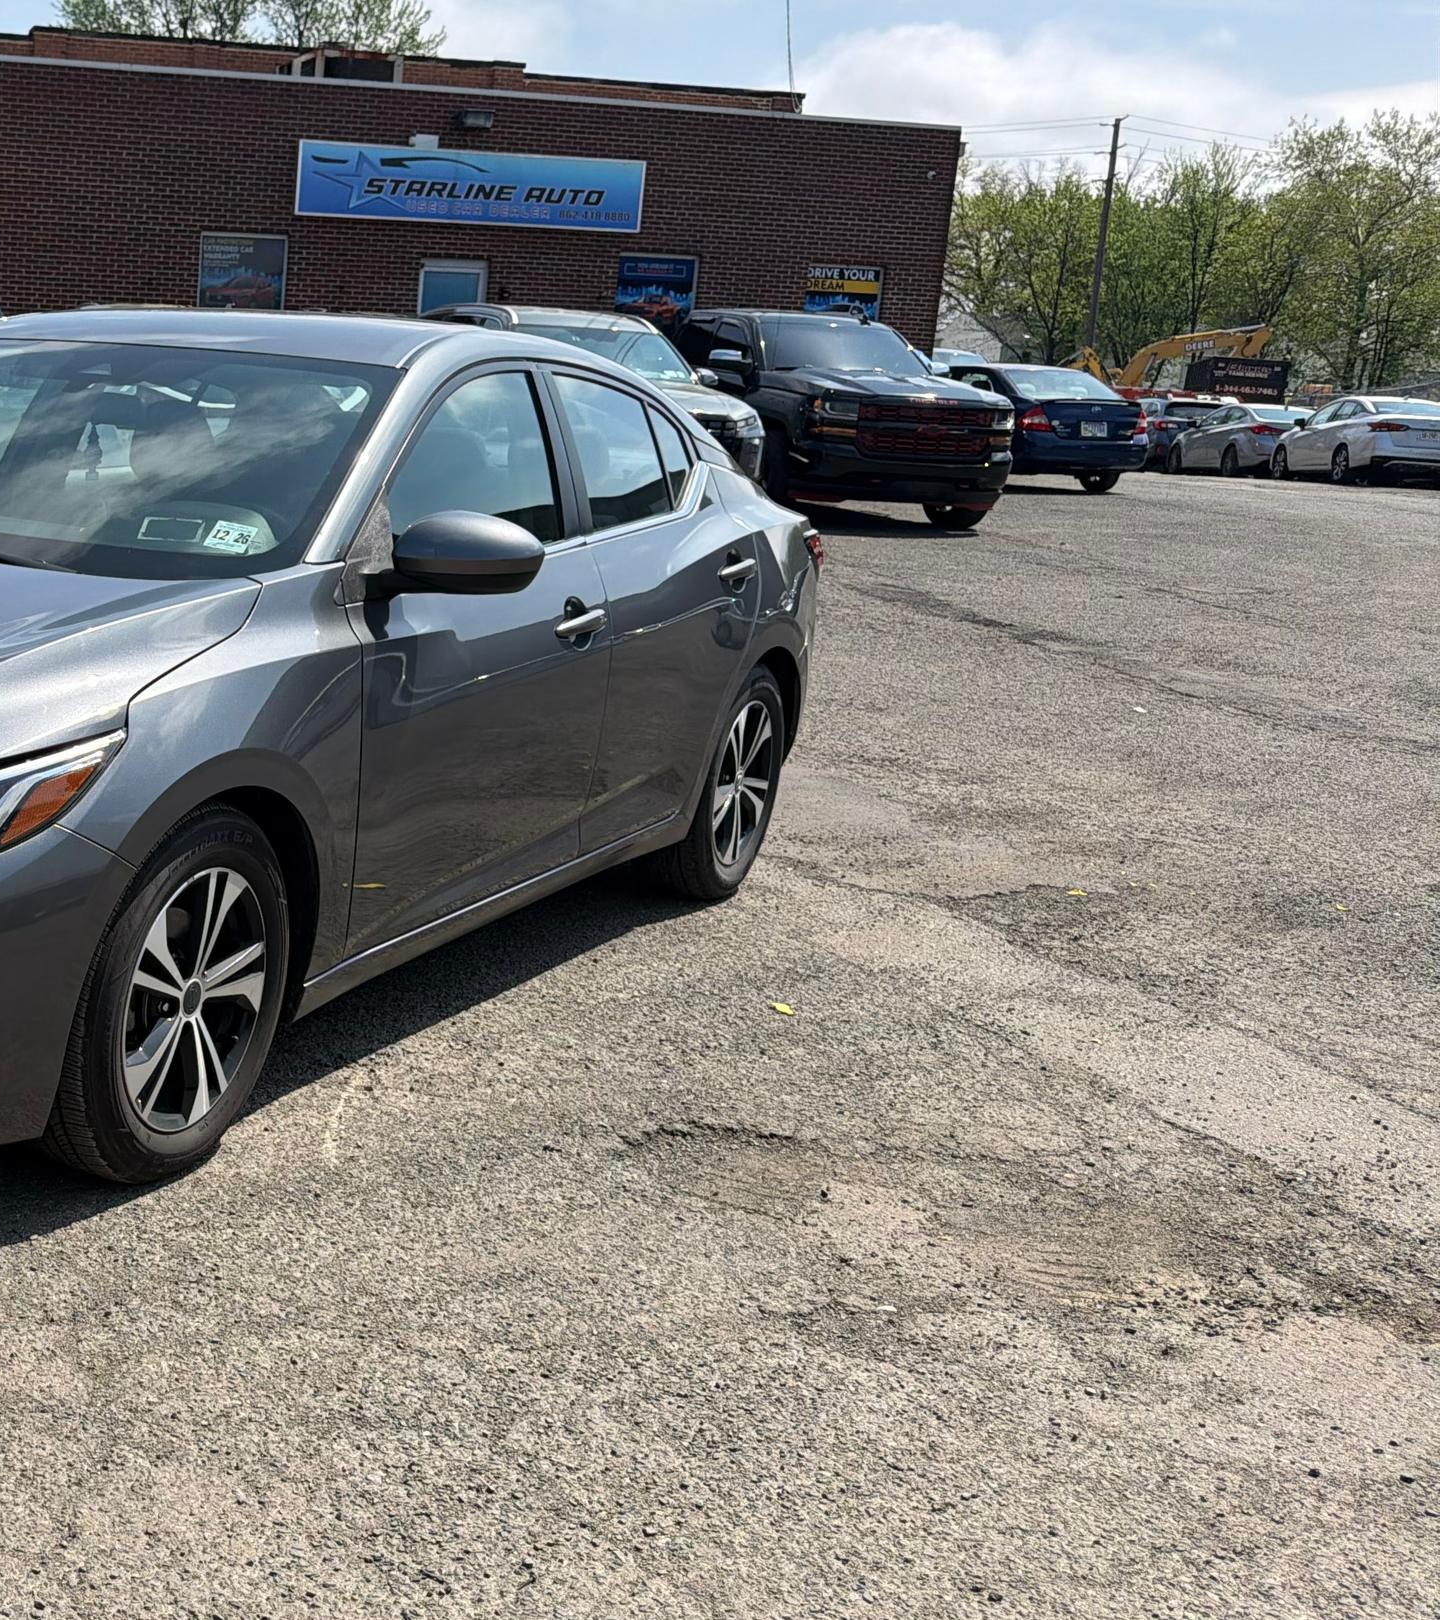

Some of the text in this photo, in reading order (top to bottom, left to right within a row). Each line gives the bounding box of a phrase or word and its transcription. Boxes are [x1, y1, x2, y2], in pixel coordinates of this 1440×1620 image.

[363, 178, 606, 206] STARLINE AUTO
[407, 199, 551, 219] USED CAR DEALER
[240, 246, 254, 254] CAR
[807, 266, 876, 281] DRIVE YOUR
[806, 279, 845, 291] DREAM
[1185, 340, 1215, 351] DEERE
[212, 529, 230, 541] 12
[233, 532, 251, 545] 26
